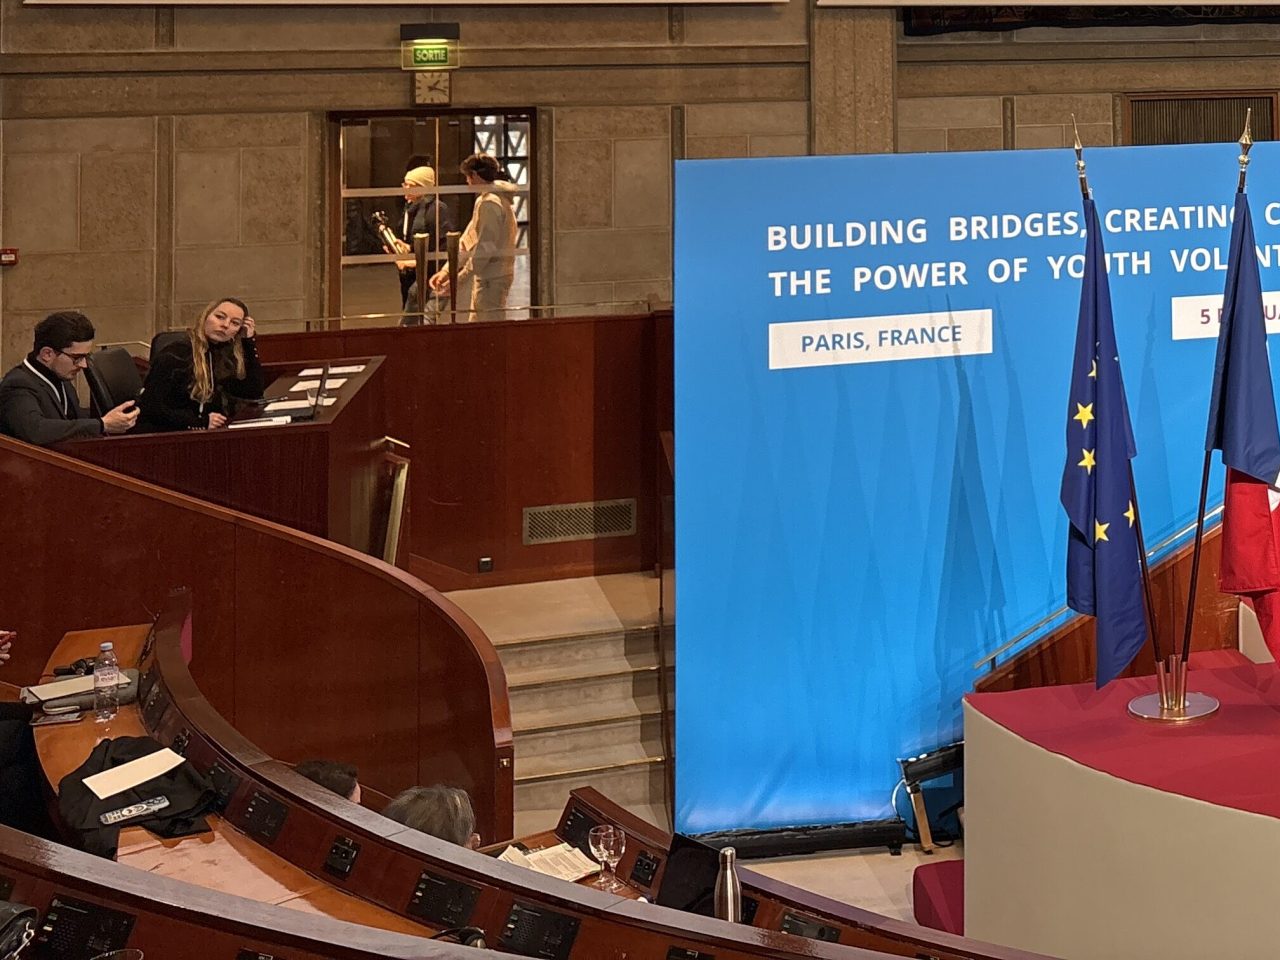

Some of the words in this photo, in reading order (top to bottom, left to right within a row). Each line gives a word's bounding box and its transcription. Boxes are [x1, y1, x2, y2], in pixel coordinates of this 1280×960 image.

[415, 50, 446, 61] SORTIE
[767, 218, 928, 251] BUILDING
[948, 211, 1087, 241] BRIDGES,
[1105, 204, 1235, 233] CREATIN
[768, 268, 831, 297] THE
[853, 260, 968, 291] POWER
[987, 257, 1028, 284] OF
[1199, 308, 1212, 325] 5
[800, 330, 872, 354] PARIS,
[877, 324, 963, 347] FRANCE
